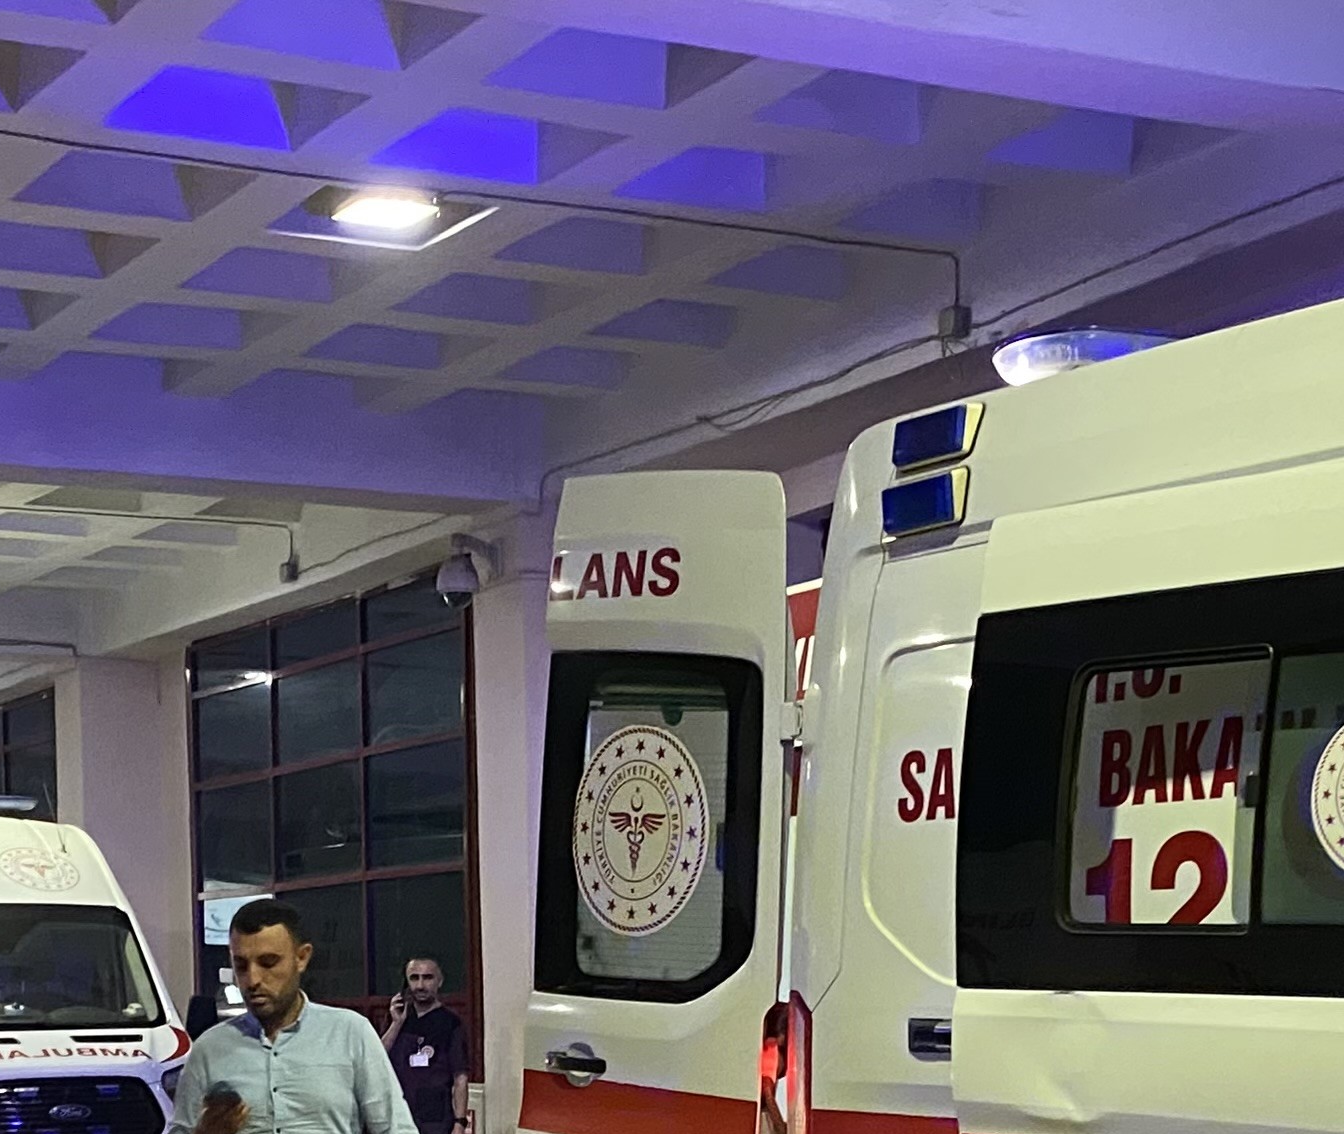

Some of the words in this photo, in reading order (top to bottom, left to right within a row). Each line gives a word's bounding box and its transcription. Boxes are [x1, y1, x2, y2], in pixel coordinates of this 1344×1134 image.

[549, 547, 681, 601] LANS
[897, 747, 956, 823] SA
[1099, 716, 1244, 807] BAKA
